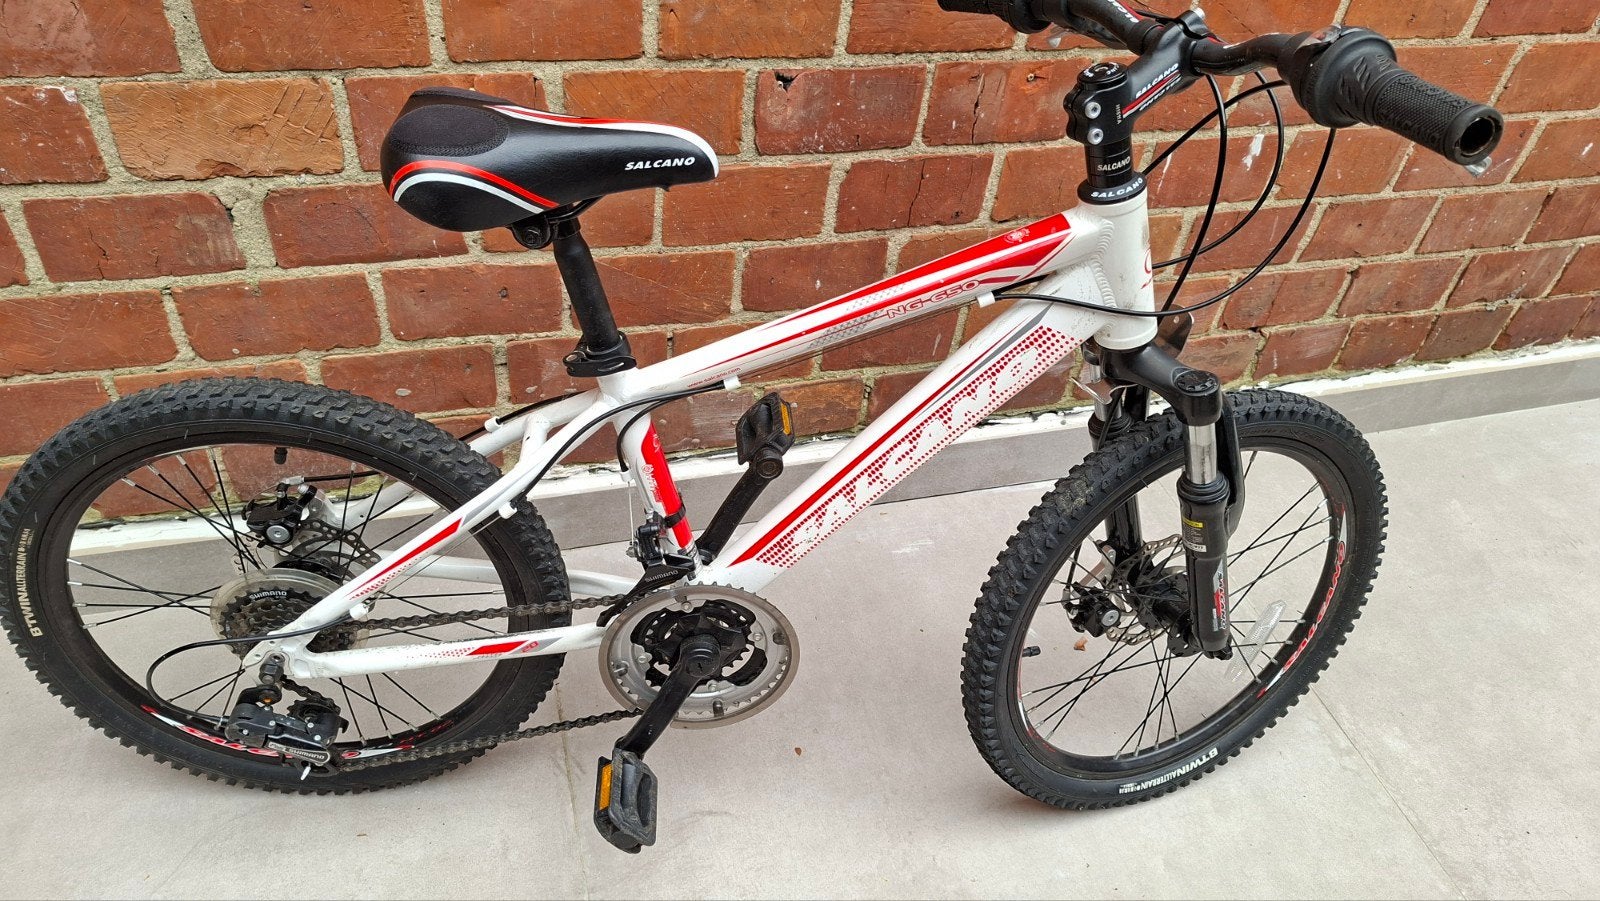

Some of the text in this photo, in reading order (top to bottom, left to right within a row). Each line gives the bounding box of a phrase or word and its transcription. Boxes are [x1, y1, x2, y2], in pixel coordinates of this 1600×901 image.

[1136, 63, 1179, 99] SALCANO
[624, 156, 696, 171] SALCANO
[1097, 155, 1131, 172] SALCANO
[1091, 177, 1143, 198] SALCANO
[886, 279, 982, 319] NG-650
[249, 590, 287, 600] SHIMANO
